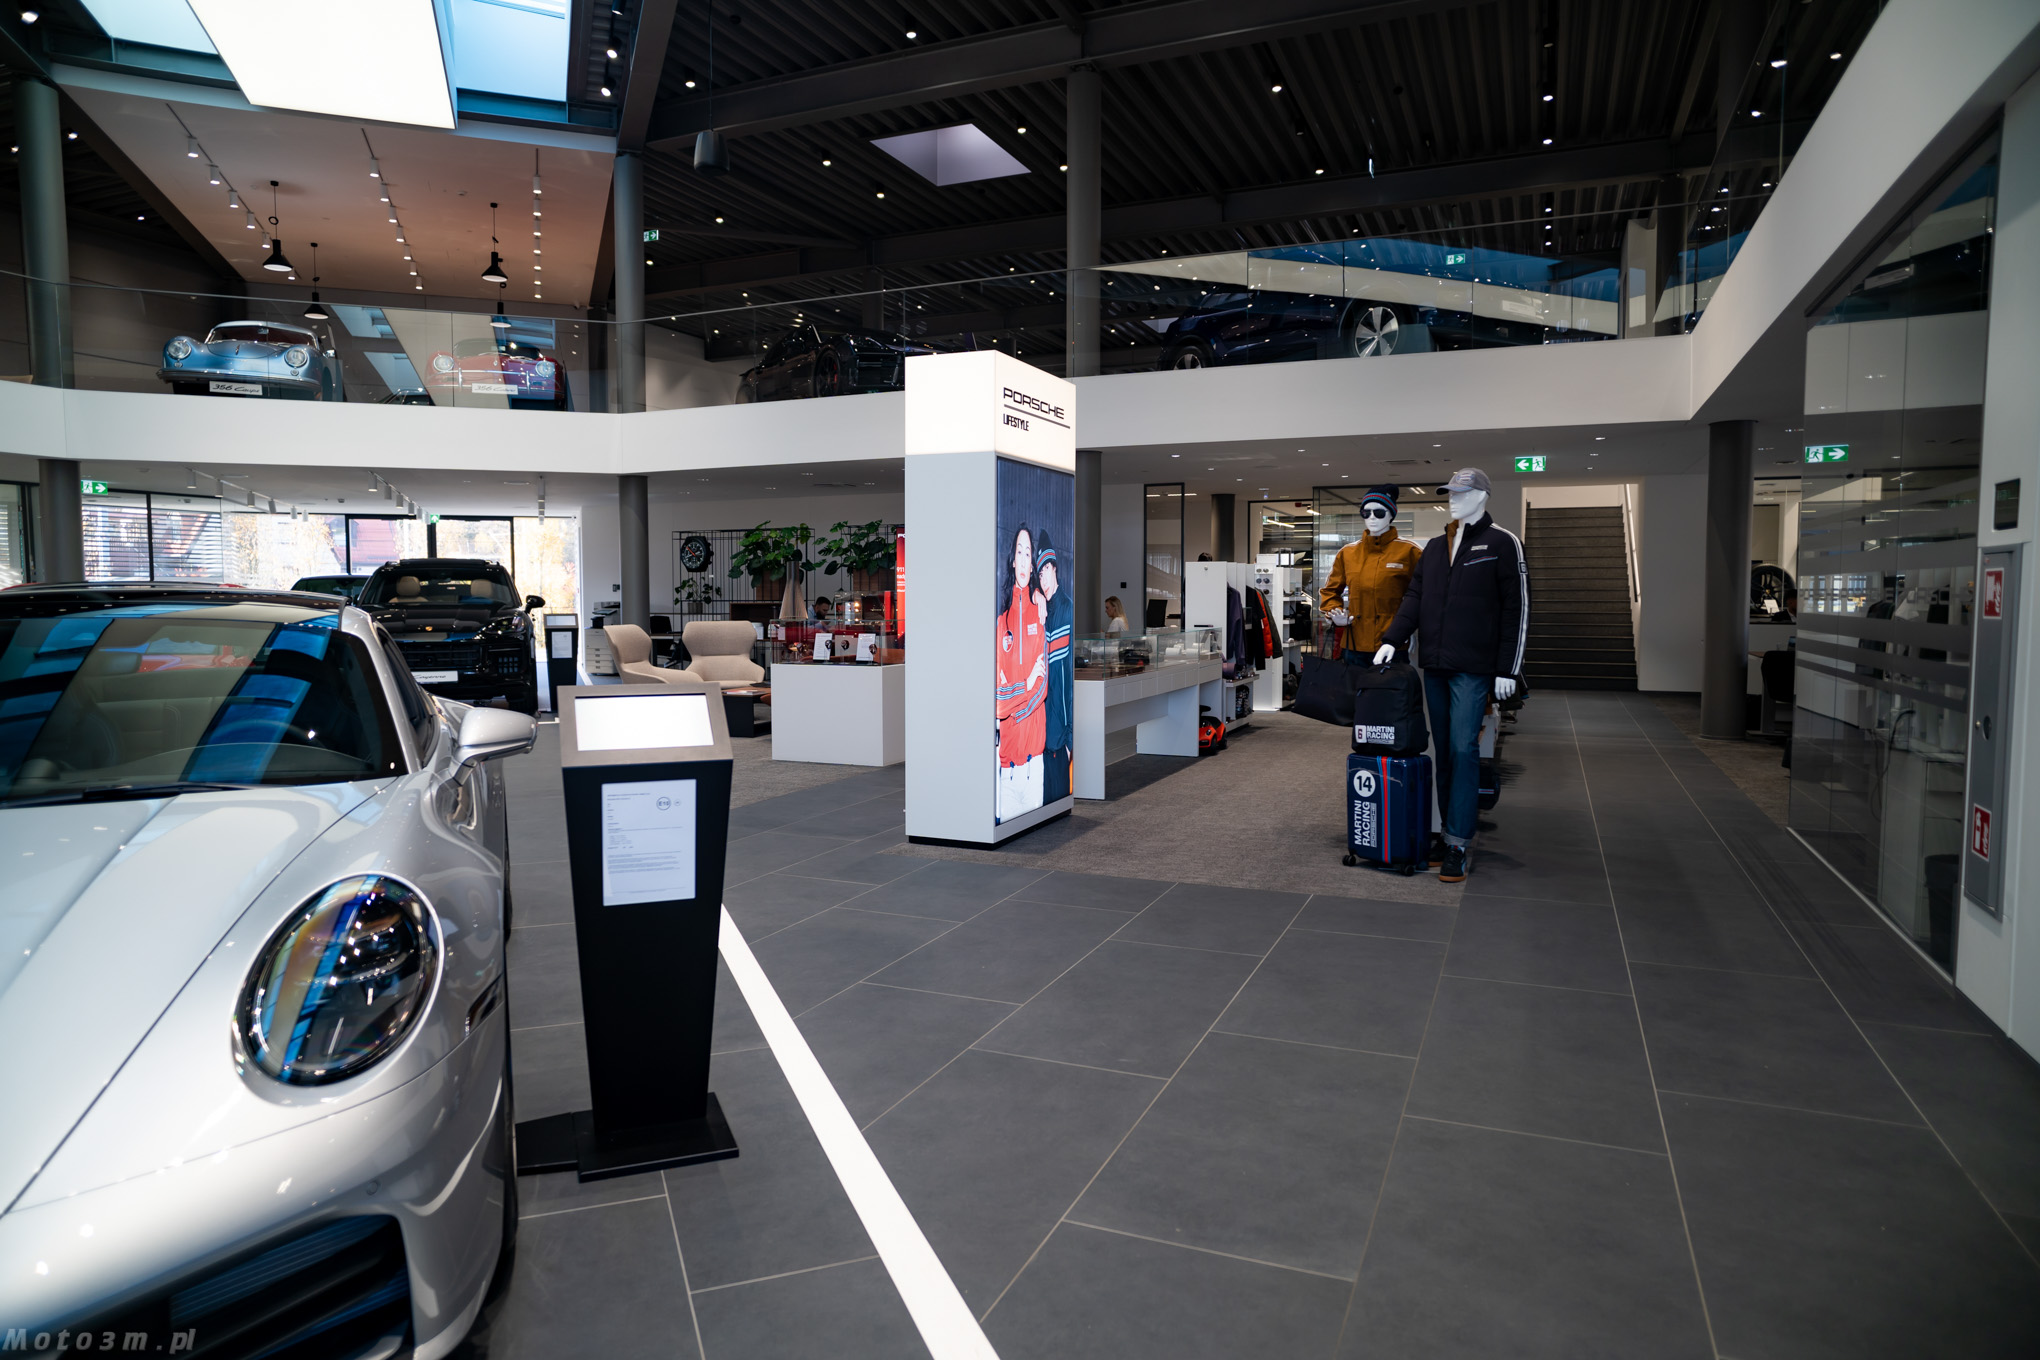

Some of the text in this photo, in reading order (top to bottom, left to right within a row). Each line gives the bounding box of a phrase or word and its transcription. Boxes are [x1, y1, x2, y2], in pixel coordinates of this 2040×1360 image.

[1003, 387, 1064, 420] PORSCHE
[1003, 413, 1029, 431] LIFESTYLE
[1358, 728, 1363, 739] 6
[1366, 725, 1395, 733] MARTINI
[1366, 731, 1395, 740] RACING
[1356, 775, 1372, 792] 14
[1354, 800, 1362, 845] MARTINI
[1362, 801, 1371, 846] RACING
